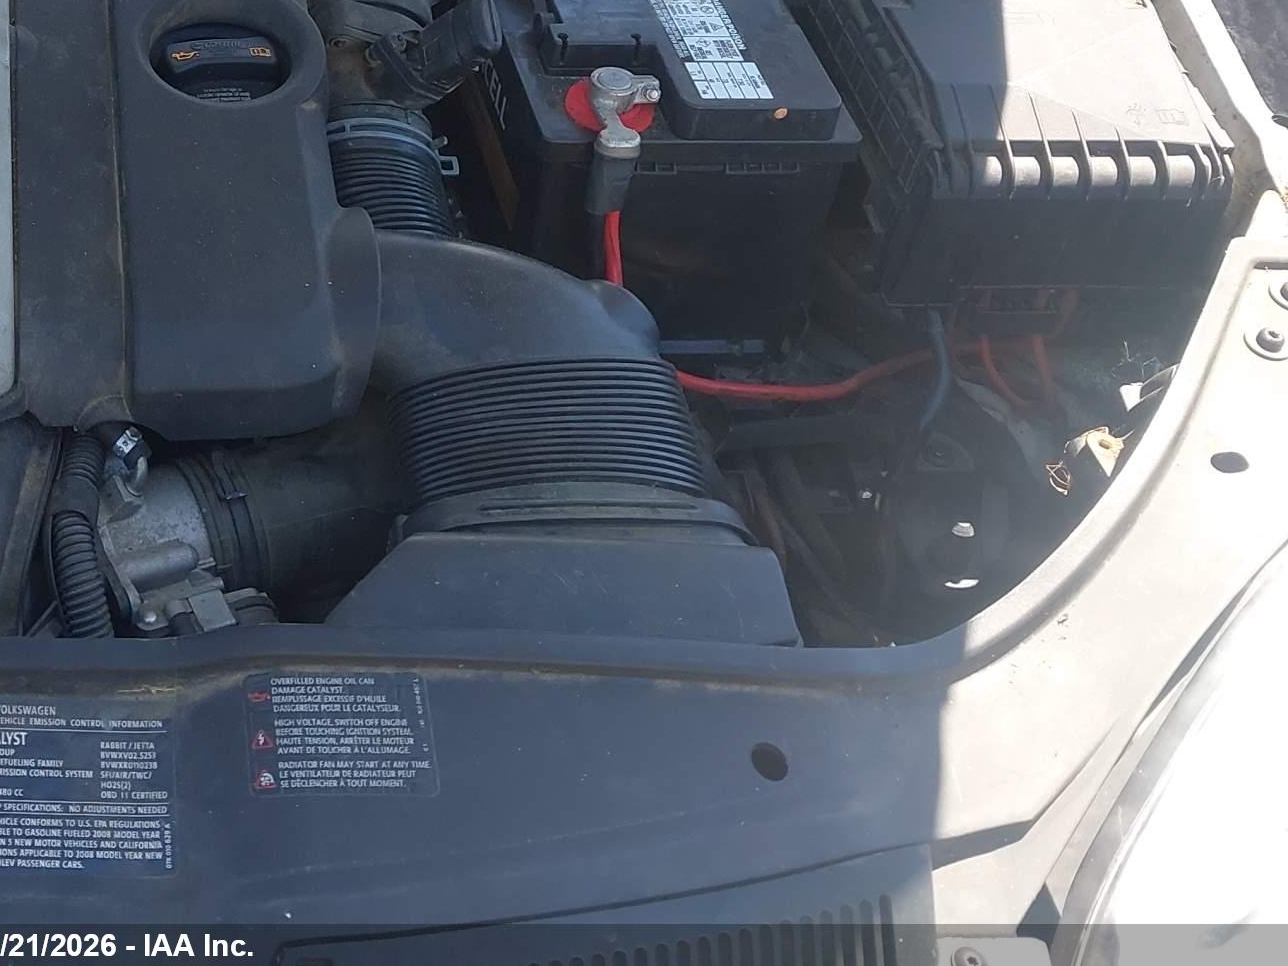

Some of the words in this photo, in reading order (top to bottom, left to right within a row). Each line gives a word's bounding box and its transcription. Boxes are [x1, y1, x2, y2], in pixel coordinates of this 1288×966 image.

[726, 25, 747, 50] POISON
[273, 704, 319, 712] DANGEREUX
[30, 718, 66, 726] EMISSION
[71, 719, 105, 727] CONTROL
[109, 720, 162, 728] INFORMATION
[276, 728, 303, 736] BEFORE
[317, 746, 351, 754] TOUCHER
[279, 761, 318, 769] RADIATOR
[65, 770, 93, 778] SYSTEM
[290, 770, 340, 778] VENTILATEUR
[342, 770, 352, 778] DE
[353, 770, 395, 778] RADIATEUR
[281, 780, 289, 788] SE
[14, 789, 24, 797] CC
[4, 804, 64, 812] SPECIFICATIONS:
[69, 805, 80, 813] NO
[83, 806, 136, 814] ADJUSTMENTS
[20, 818, 63, 827] CONFORMS
[66, 819, 75, 827] TO
[78, 819, 92, 827] U.S.
[109, 820, 160, 828] REGULATIONS
[13, 828, 22, 836] TO
[34, 839, 62, 847] MOTOR
[64, 840, 98, 848] VEHICLES
[119, 841, 162, 849] CALIFORNIA
[19, 849, 61, 857] APPLICABLE
[64, 850, 73, 858] TO
[96, 850, 122, 859] MODEL
[124, 851, 143, 859] YEAR
[145, 852, 163, 860] NEW
[17, 860, 60, 868] PASSENGER
[62, 861, 84, 869] CARS.
